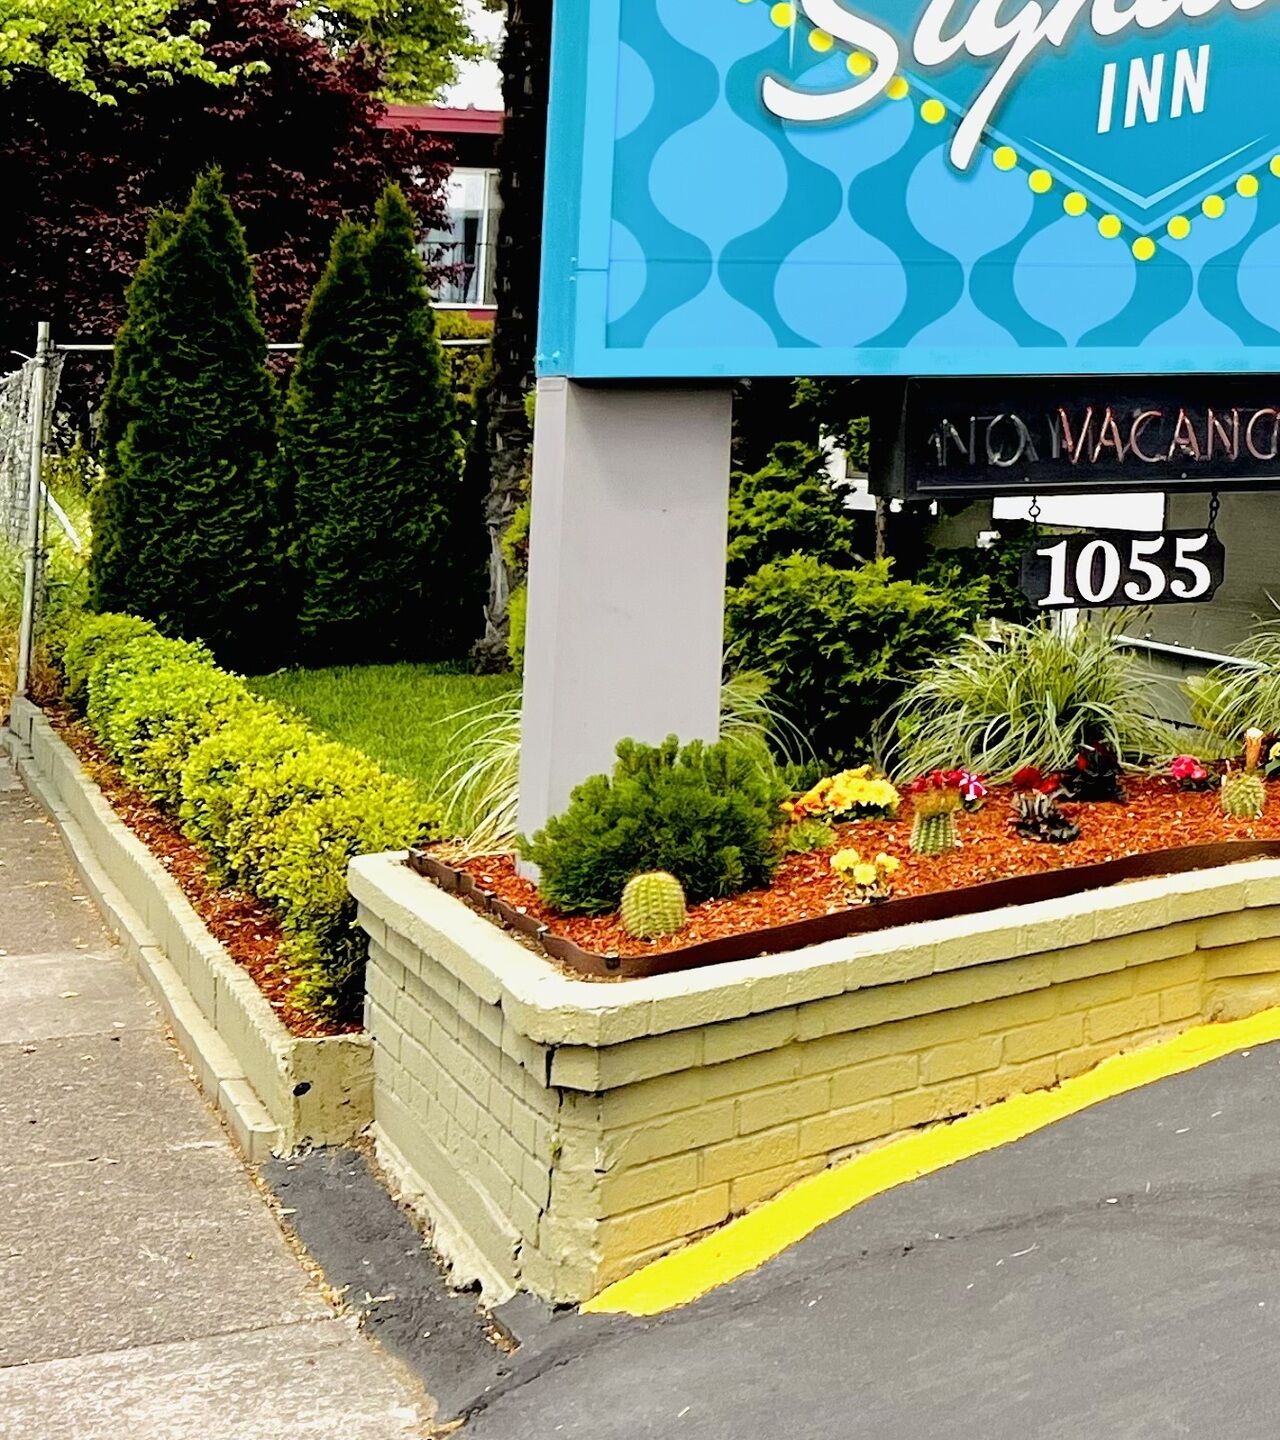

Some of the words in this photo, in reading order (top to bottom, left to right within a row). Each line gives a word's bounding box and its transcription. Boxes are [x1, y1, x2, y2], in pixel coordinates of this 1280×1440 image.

[1097, 44, 1211, 134] INN
[928, 413, 1026, 468] NO
[1036, 532, 1212, 607] 1055
